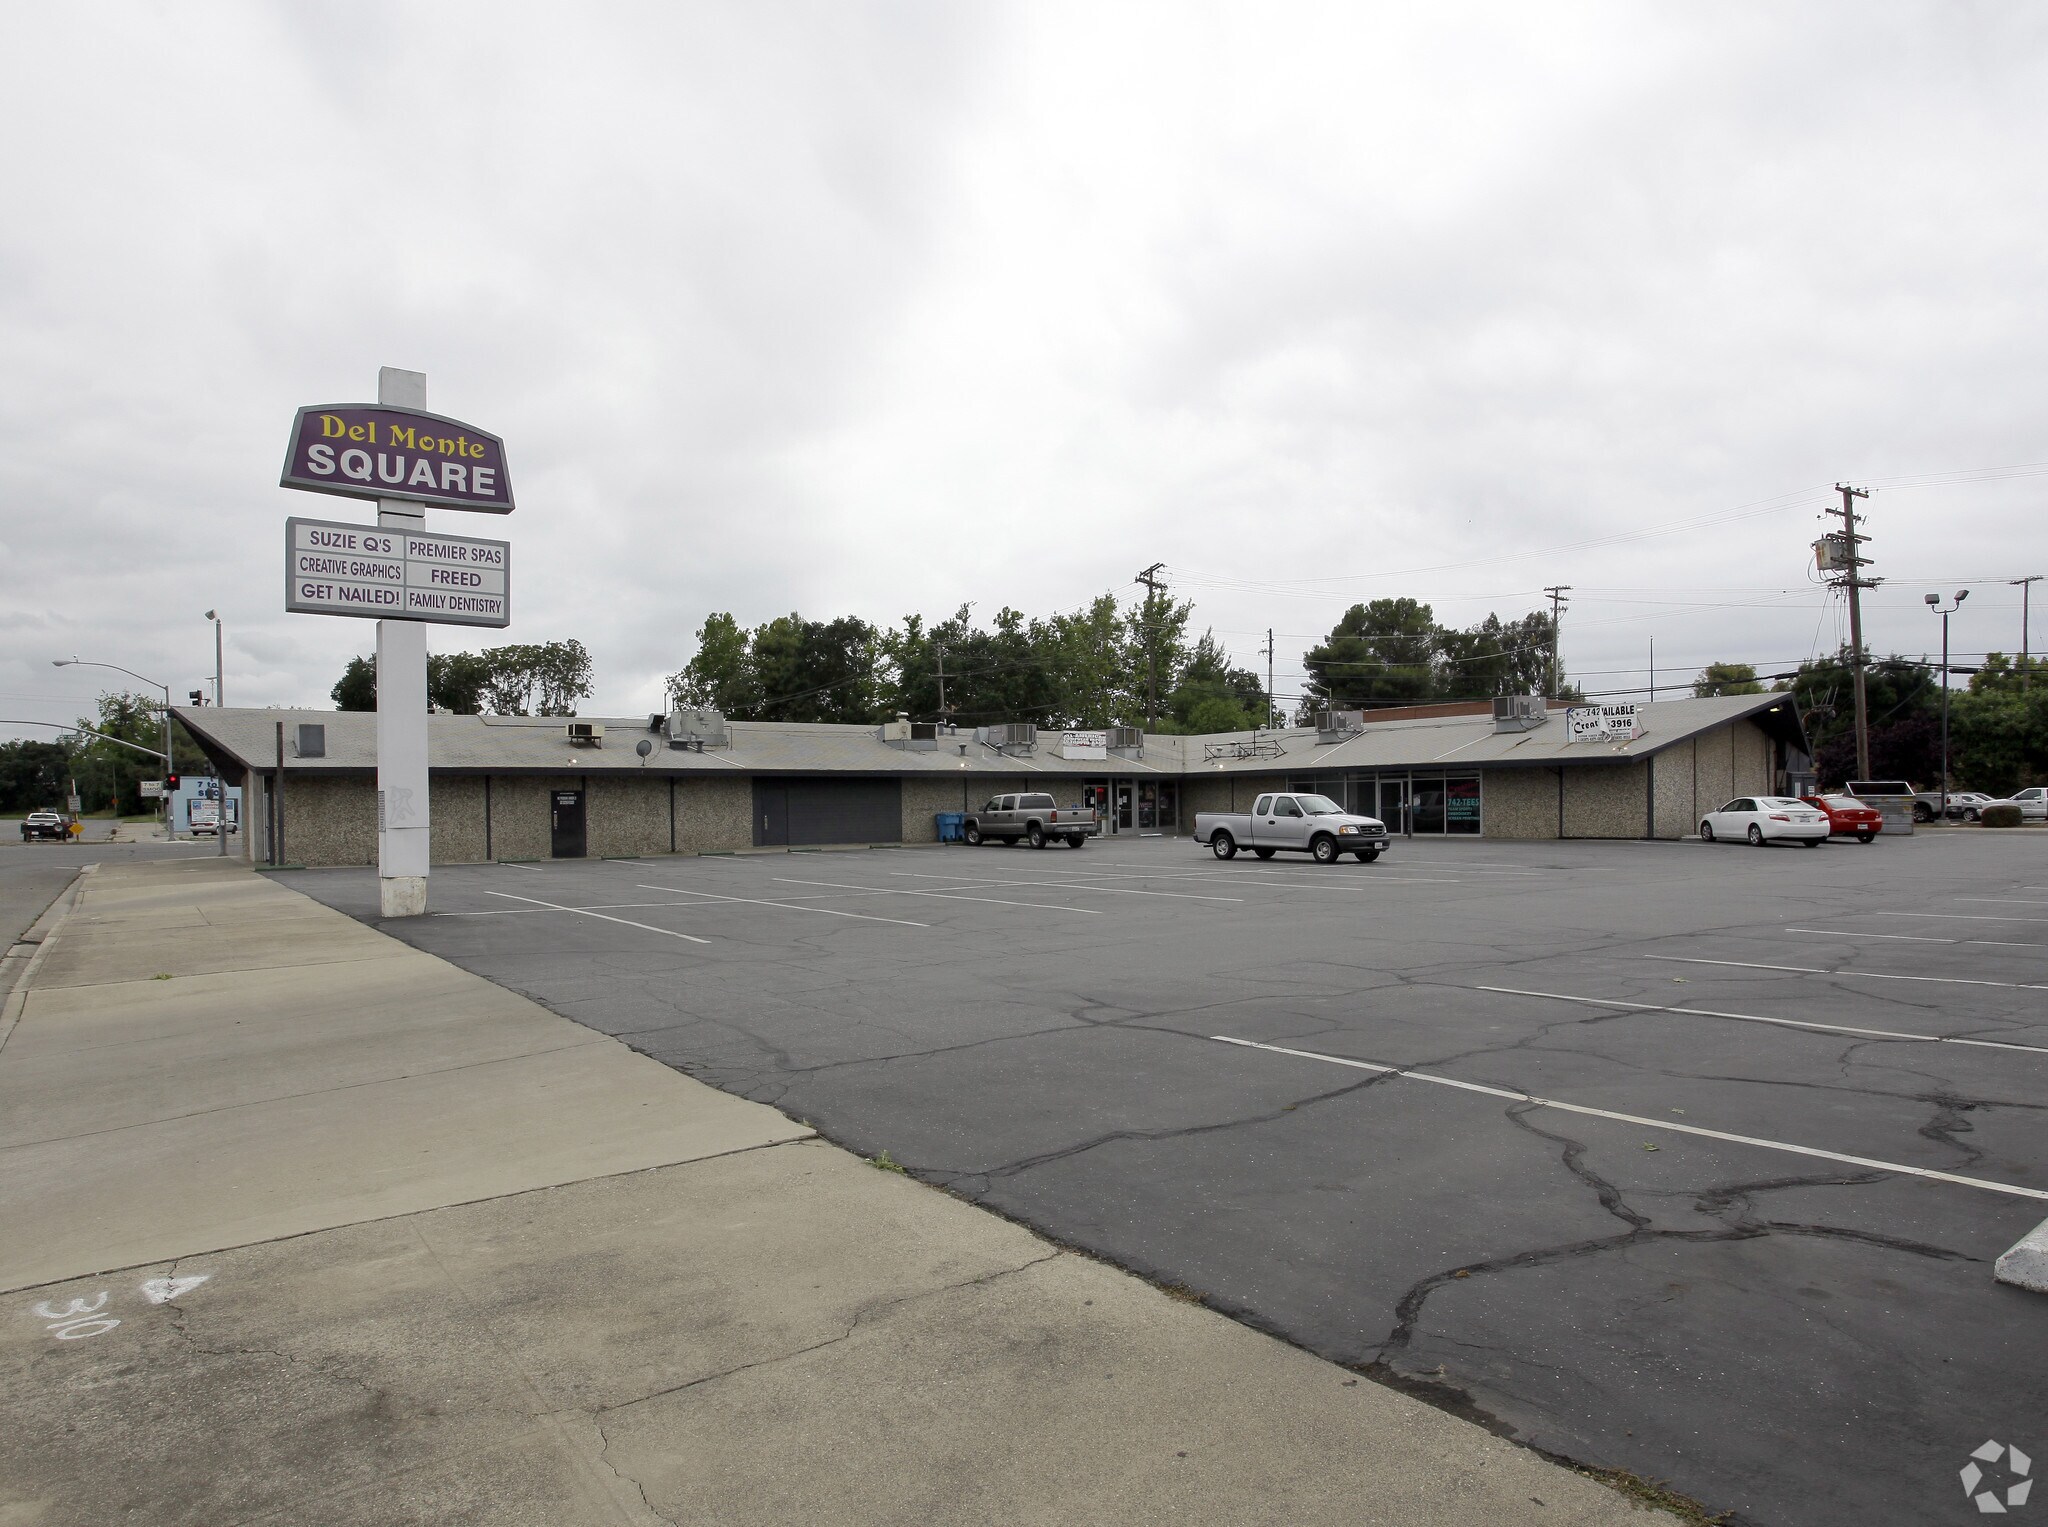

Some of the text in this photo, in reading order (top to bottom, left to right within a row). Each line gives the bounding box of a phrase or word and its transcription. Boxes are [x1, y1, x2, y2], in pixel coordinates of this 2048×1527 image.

[319, 414, 486, 459] Del Monte
[307, 443, 496, 496] SQUARE
[310, 530, 392, 553] SUZIE Q'S
[409, 541, 502, 564] PREMIER SPAS
[300, 556, 400, 580] CREATIVE GRAPHICS
[431, 569, 482, 587] FREED
[301, 583, 400, 606] GET NAILED!
[409, 592, 502, 614] FAMILY DENTISTRY
